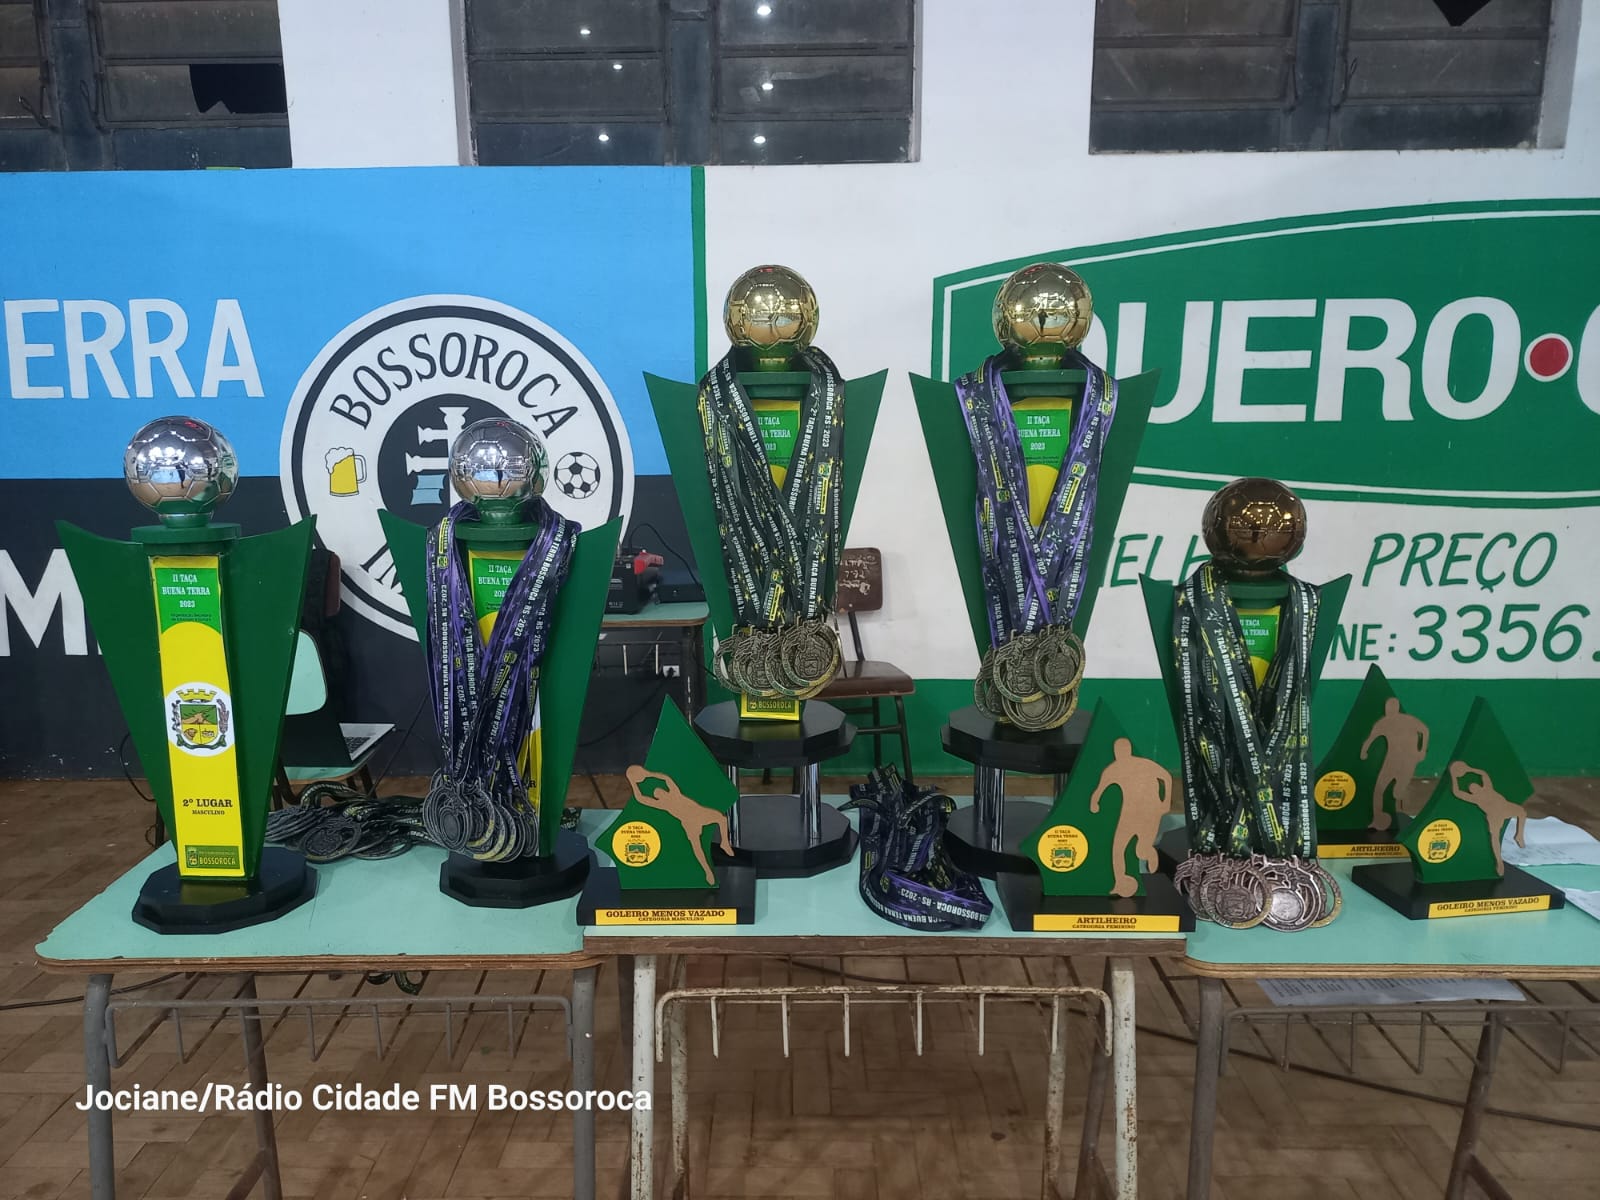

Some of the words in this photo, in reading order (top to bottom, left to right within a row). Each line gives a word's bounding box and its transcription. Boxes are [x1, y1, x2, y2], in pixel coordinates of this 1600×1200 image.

[4, 298, 265, 399] ERRA
[1081, 296, 1521, 424] UERO
[329, 332, 578, 436] BOSSOROCA
[726, 381, 750, 423] BOSSOROCA
[764, 417, 780, 427] TAÇA
[803, 415, 816, 434] TAÇA
[823, 414, 831, 424] RS
[1027, 416, 1033, 425] II
[1034, 416, 1050, 426] TAÇA
[1089, 415, 1099, 426] RS
[744, 420, 758, 444] TERRA
[770, 429, 791, 438] TERRA
[821, 428, 830, 447] 2023
[1039, 429, 1061, 437] TERRA
[1081, 429, 1094, 449] 2023
[799, 433, 811, 456] BUENA
[1030, 442, 1045, 450] 2023
[794, 456, 806, 478] TERRA
[1004, 515, 1015, 534] 2023
[545, 540, 559, 563] TERRA
[1009, 538, 1017, 548] RS
[488, 564, 495, 574] II
[495, 564, 512, 576] TAÇA
[1034, 557, 1047, 575] 2023
[1071, 560, 1082, 583] BUENA
[1361, 532, 1558, 593] PREÇO
[172, 574, 178, 582] II
[180, 574, 198, 585] TAÇA
[478, 577, 500, 585] BUENA
[526, 560, 551, 603] BOSSOROCA
[1010, 552, 1025, 593] BOSSOROCA
[161, 586, 186, 595] BUENA
[186, 586, 211, 595] TERRA
[808, 577, 817, 599] BUENA
[179, 600, 196, 608] 2023
[521, 603, 532, 616] RS
[1027, 598, 1039, 620] TERRA
[1301, 591, 1309, 613] BUENA
[513, 617, 527, 638] 2023
[534, 620, 543, 630] RS
[1180, 615, 1190, 633] 2023
[1245, 619, 1260, 628] TAÇA
[441, 622, 449, 663] BOSSOROCA
[530, 633, 542, 653] 2023
[1180, 637, 1189, 647] RS
[1215, 636, 1227, 654] TAÇA
[1181, 651, 1191, 693] BOSSOROCA
[1220, 653, 1234, 676] BUENA
[455, 684, 466, 702] 2023
[1227, 675, 1240, 697] TERRA
[1233, 696, 1252, 738] BOSSOROCA
[1245, 741, 1255, 752] RS
[1249, 755, 1262, 775] 2023
[1283, 763, 1292, 782] 2023
[1299, 761, 1307, 780] 2023
[1282, 786, 1291, 797] RS
[1300, 784, 1308, 794] RS
[196, 799, 233, 808] LUGAR
[1189, 801, 1199, 820] 2023
[1300, 798, 1310, 840] BOSSOROCA
[199, 856, 236, 865] BOSSOROCA
[899, 887, 919, 901] 2023
[920, 895, 932, 906] RS
[934, 898, 979, 922] BOSSOROCA
[1436, 903, 1474, 911] GOLEIRO
[1476, 900, 1507, 908] MENOS
[1508, 897, 1540, 906] VAZADO
[606, 910, 650, 918] GOLEIRO
